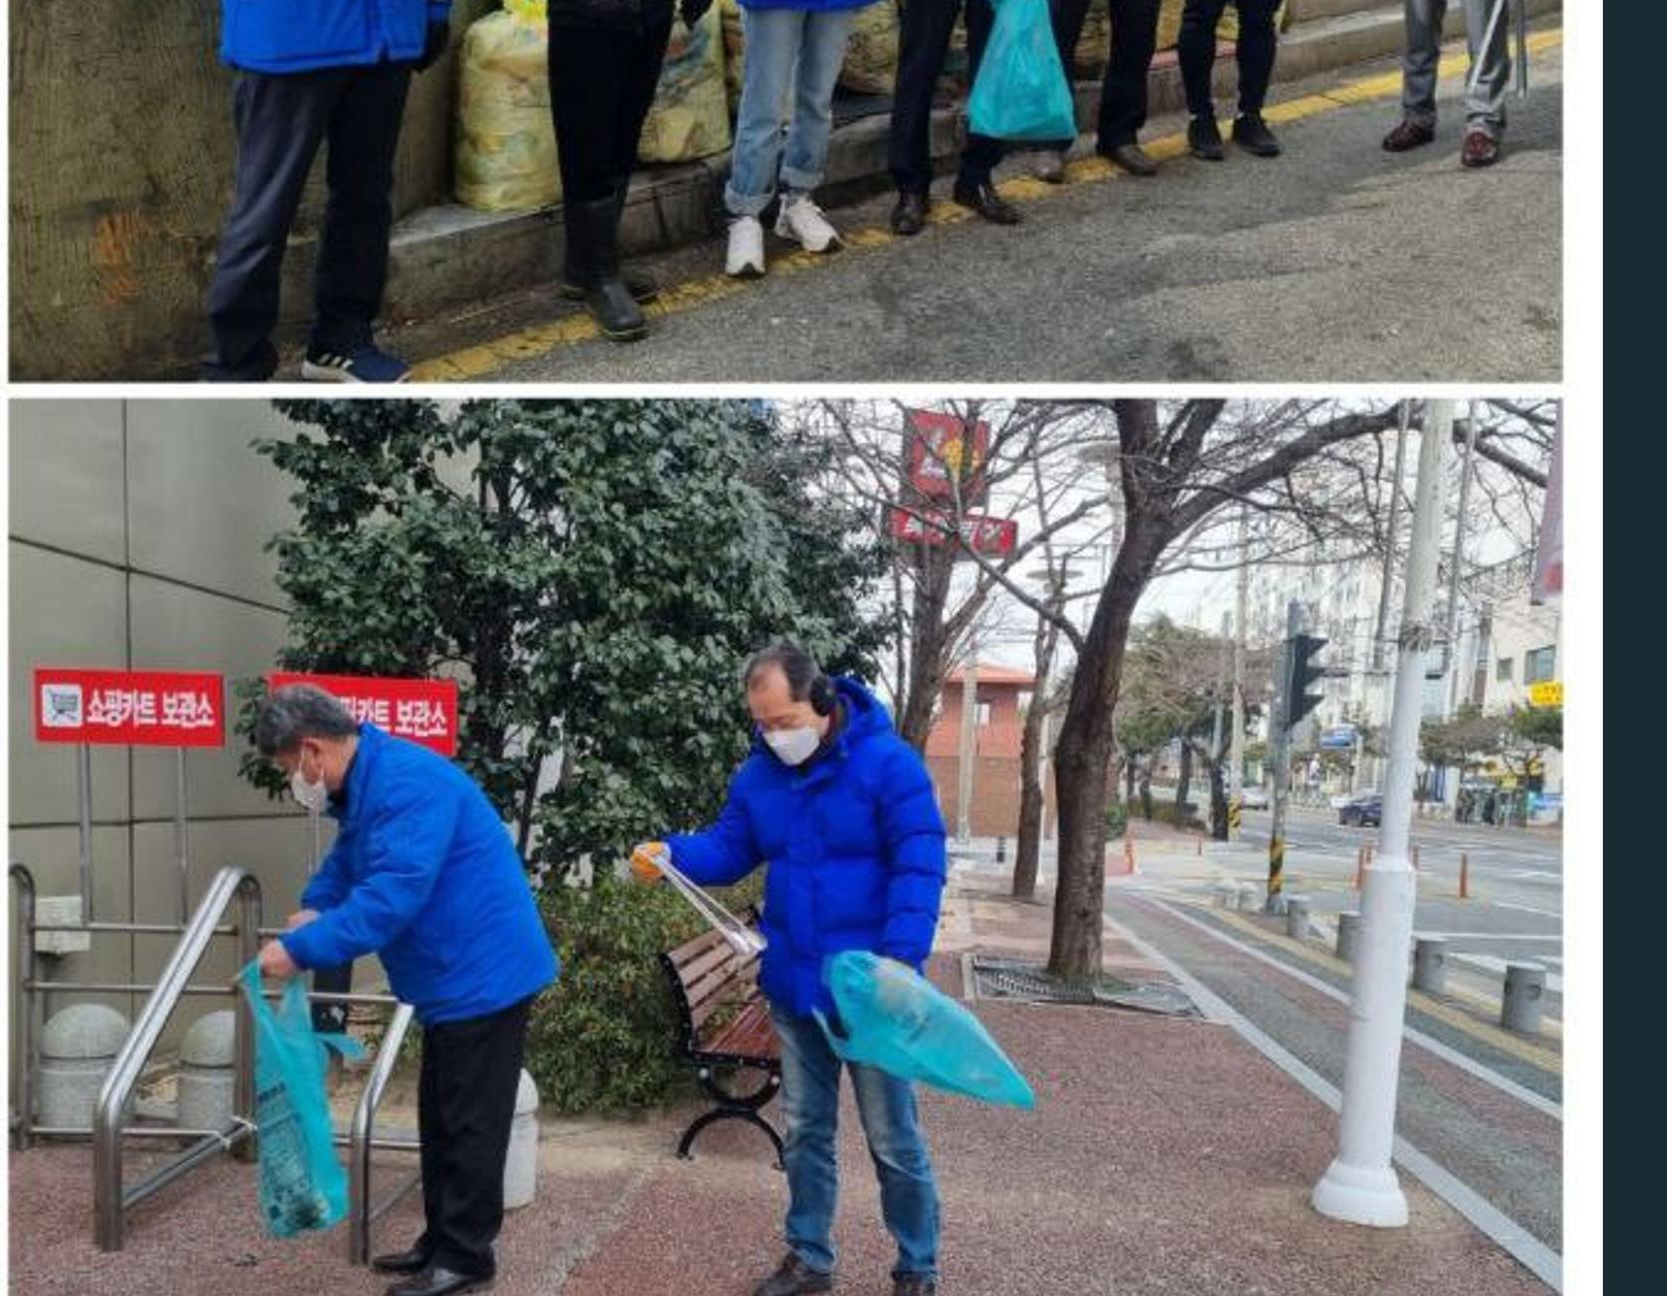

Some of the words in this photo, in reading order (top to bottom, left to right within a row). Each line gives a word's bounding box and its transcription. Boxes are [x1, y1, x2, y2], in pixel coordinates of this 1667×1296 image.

[87, 689, 157, 728] 쇼핑카트
[161, 691, 215, 729] 보관소
[340, 696, 391, 733] 카트
[394, 699, 448, 737] 보관소
